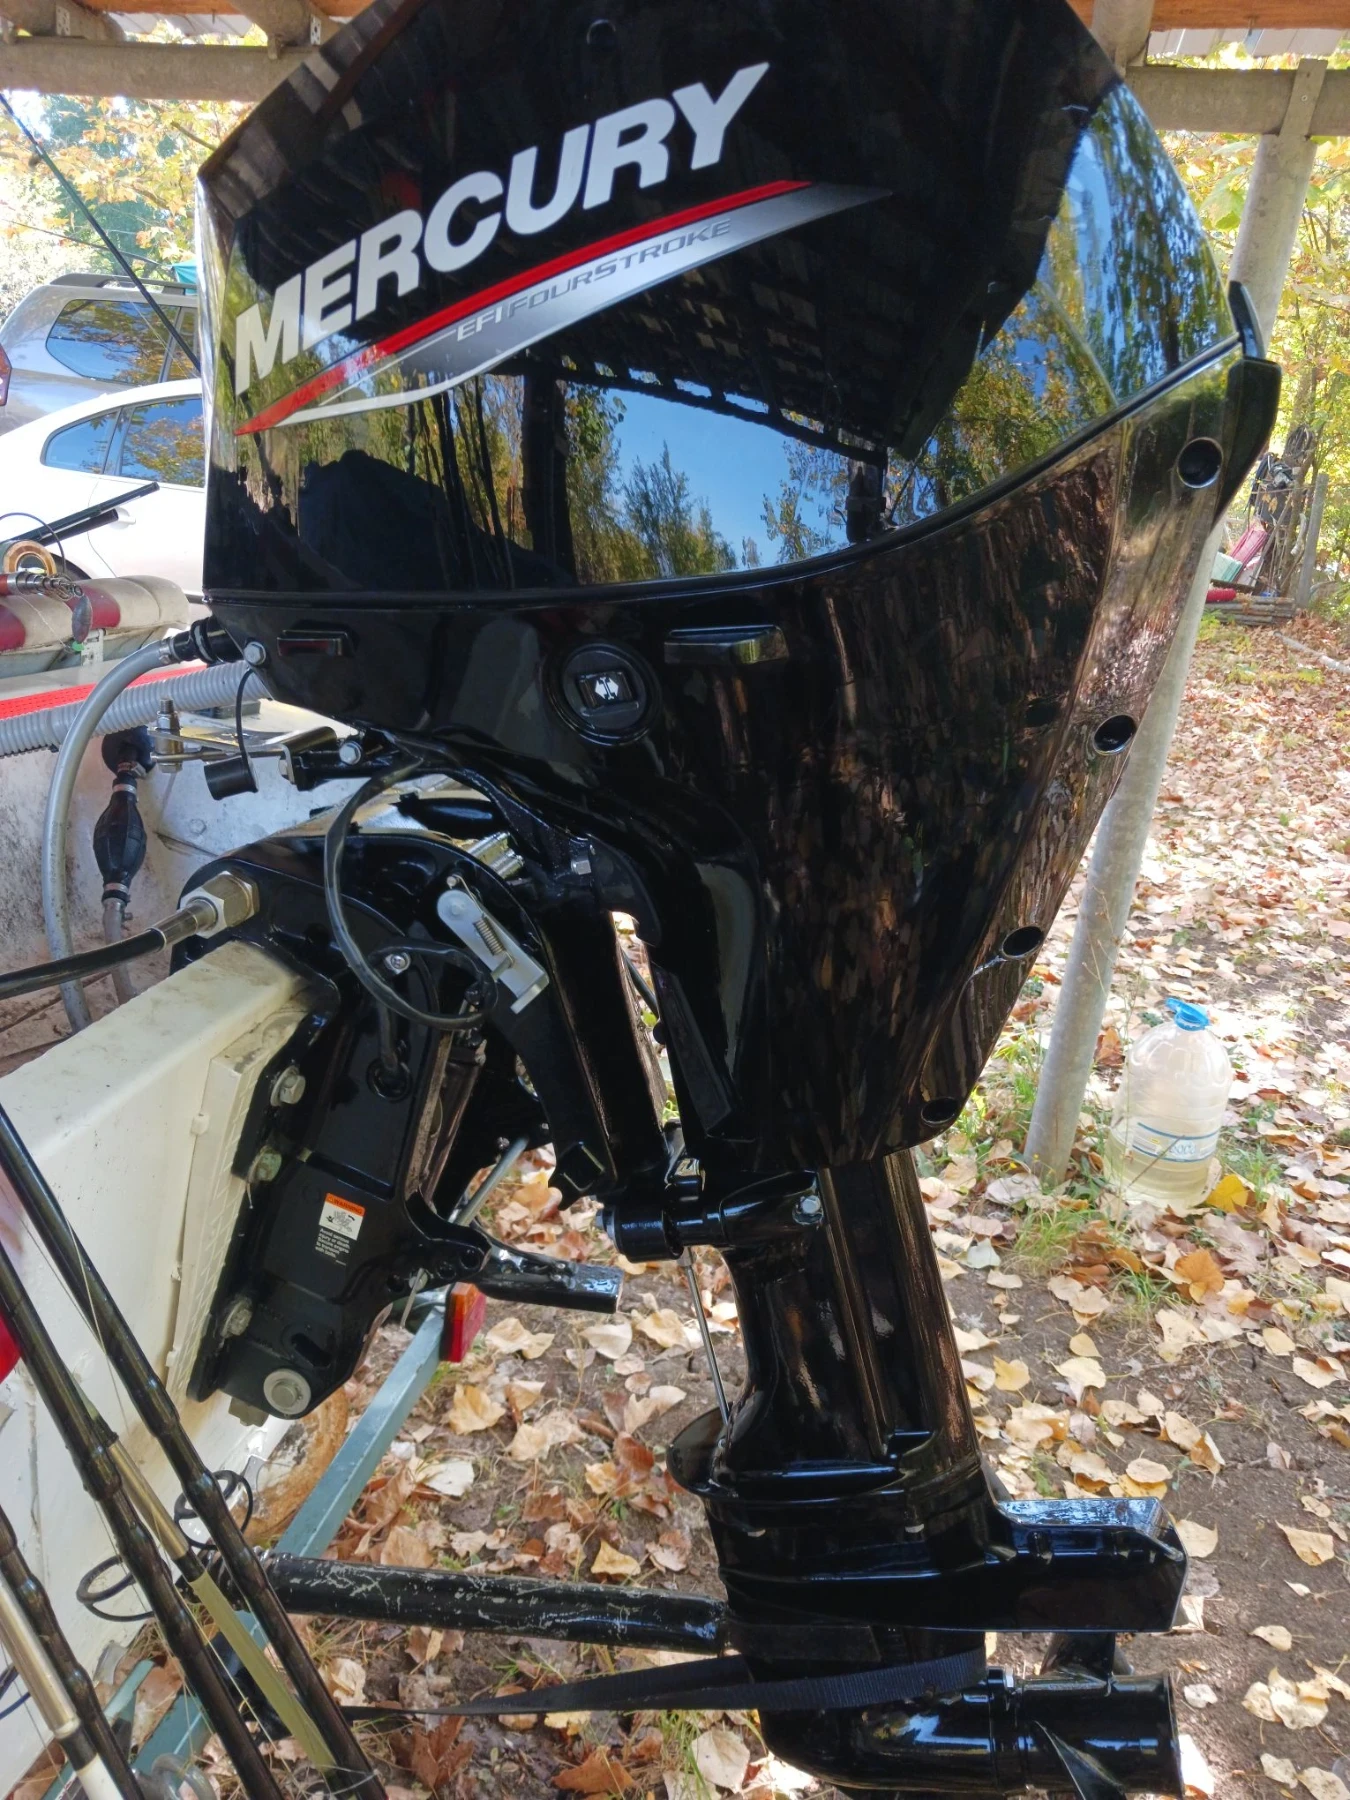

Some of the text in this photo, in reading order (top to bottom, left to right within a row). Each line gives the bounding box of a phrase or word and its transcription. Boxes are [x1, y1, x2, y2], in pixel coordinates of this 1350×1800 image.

[235, 62, 770, 396] MERCURY
[457, 219, 730, 342] EFI FOURSTROKE
[334, 1199, 363, 1214] WARNING
